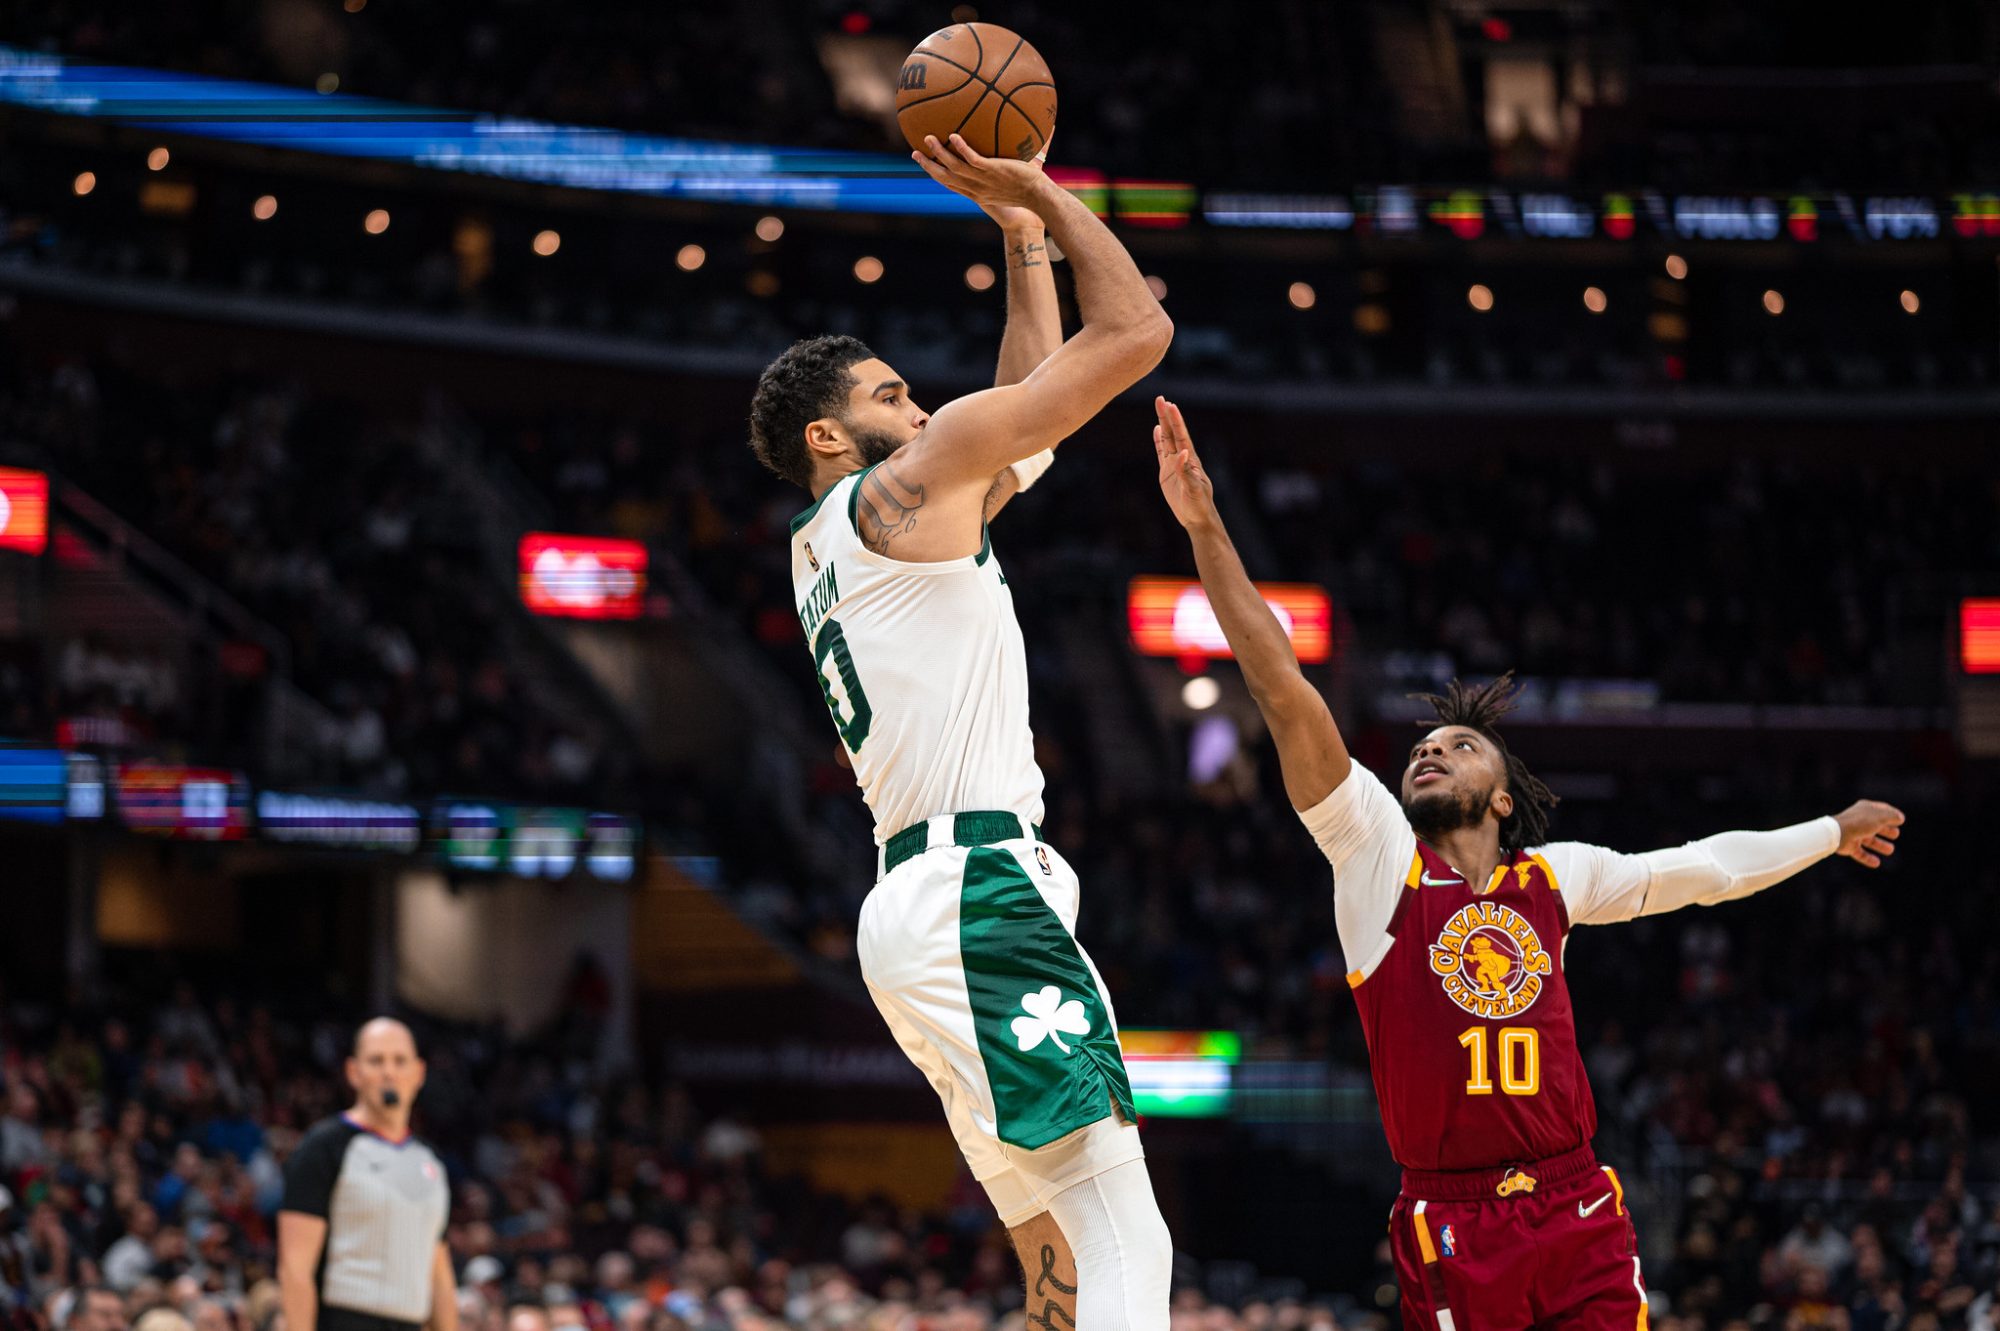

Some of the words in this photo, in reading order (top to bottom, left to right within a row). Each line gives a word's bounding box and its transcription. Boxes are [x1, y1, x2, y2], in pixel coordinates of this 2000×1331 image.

[815, 617, 872, 754] 0
[1430, 902, 1552, 974] CAVALIERS
[1442, 975, 1543, 1017] CLEVELAND
[1458, 1025, 1539, 1096] 10
